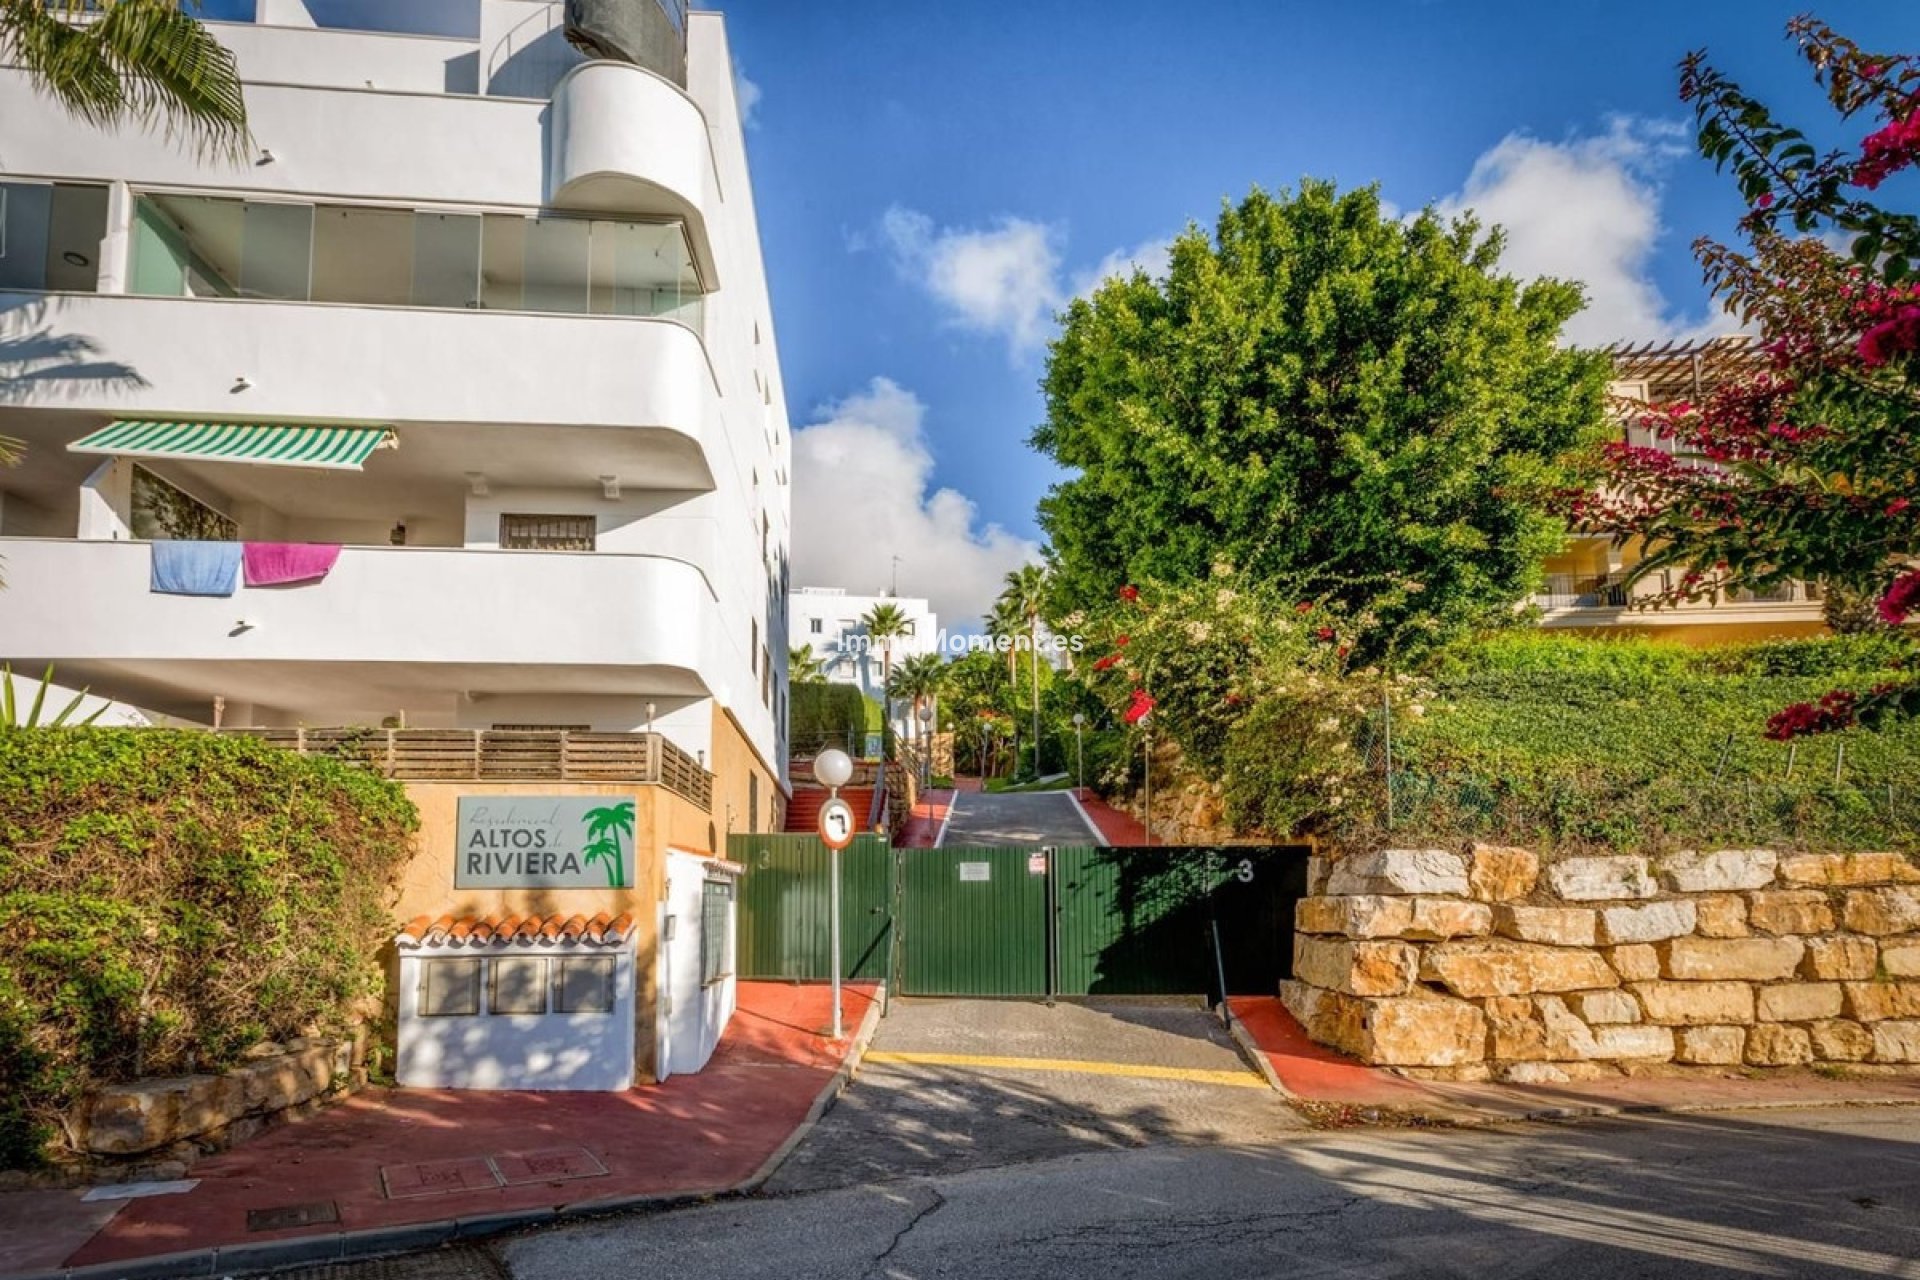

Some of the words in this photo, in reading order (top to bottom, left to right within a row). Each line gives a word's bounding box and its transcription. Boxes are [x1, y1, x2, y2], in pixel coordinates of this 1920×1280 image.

[468, 828, 547, 849] ALTOS
[466, 852, 582, 876] RIVIERA
[1238, 859, 1254, 883] 3
